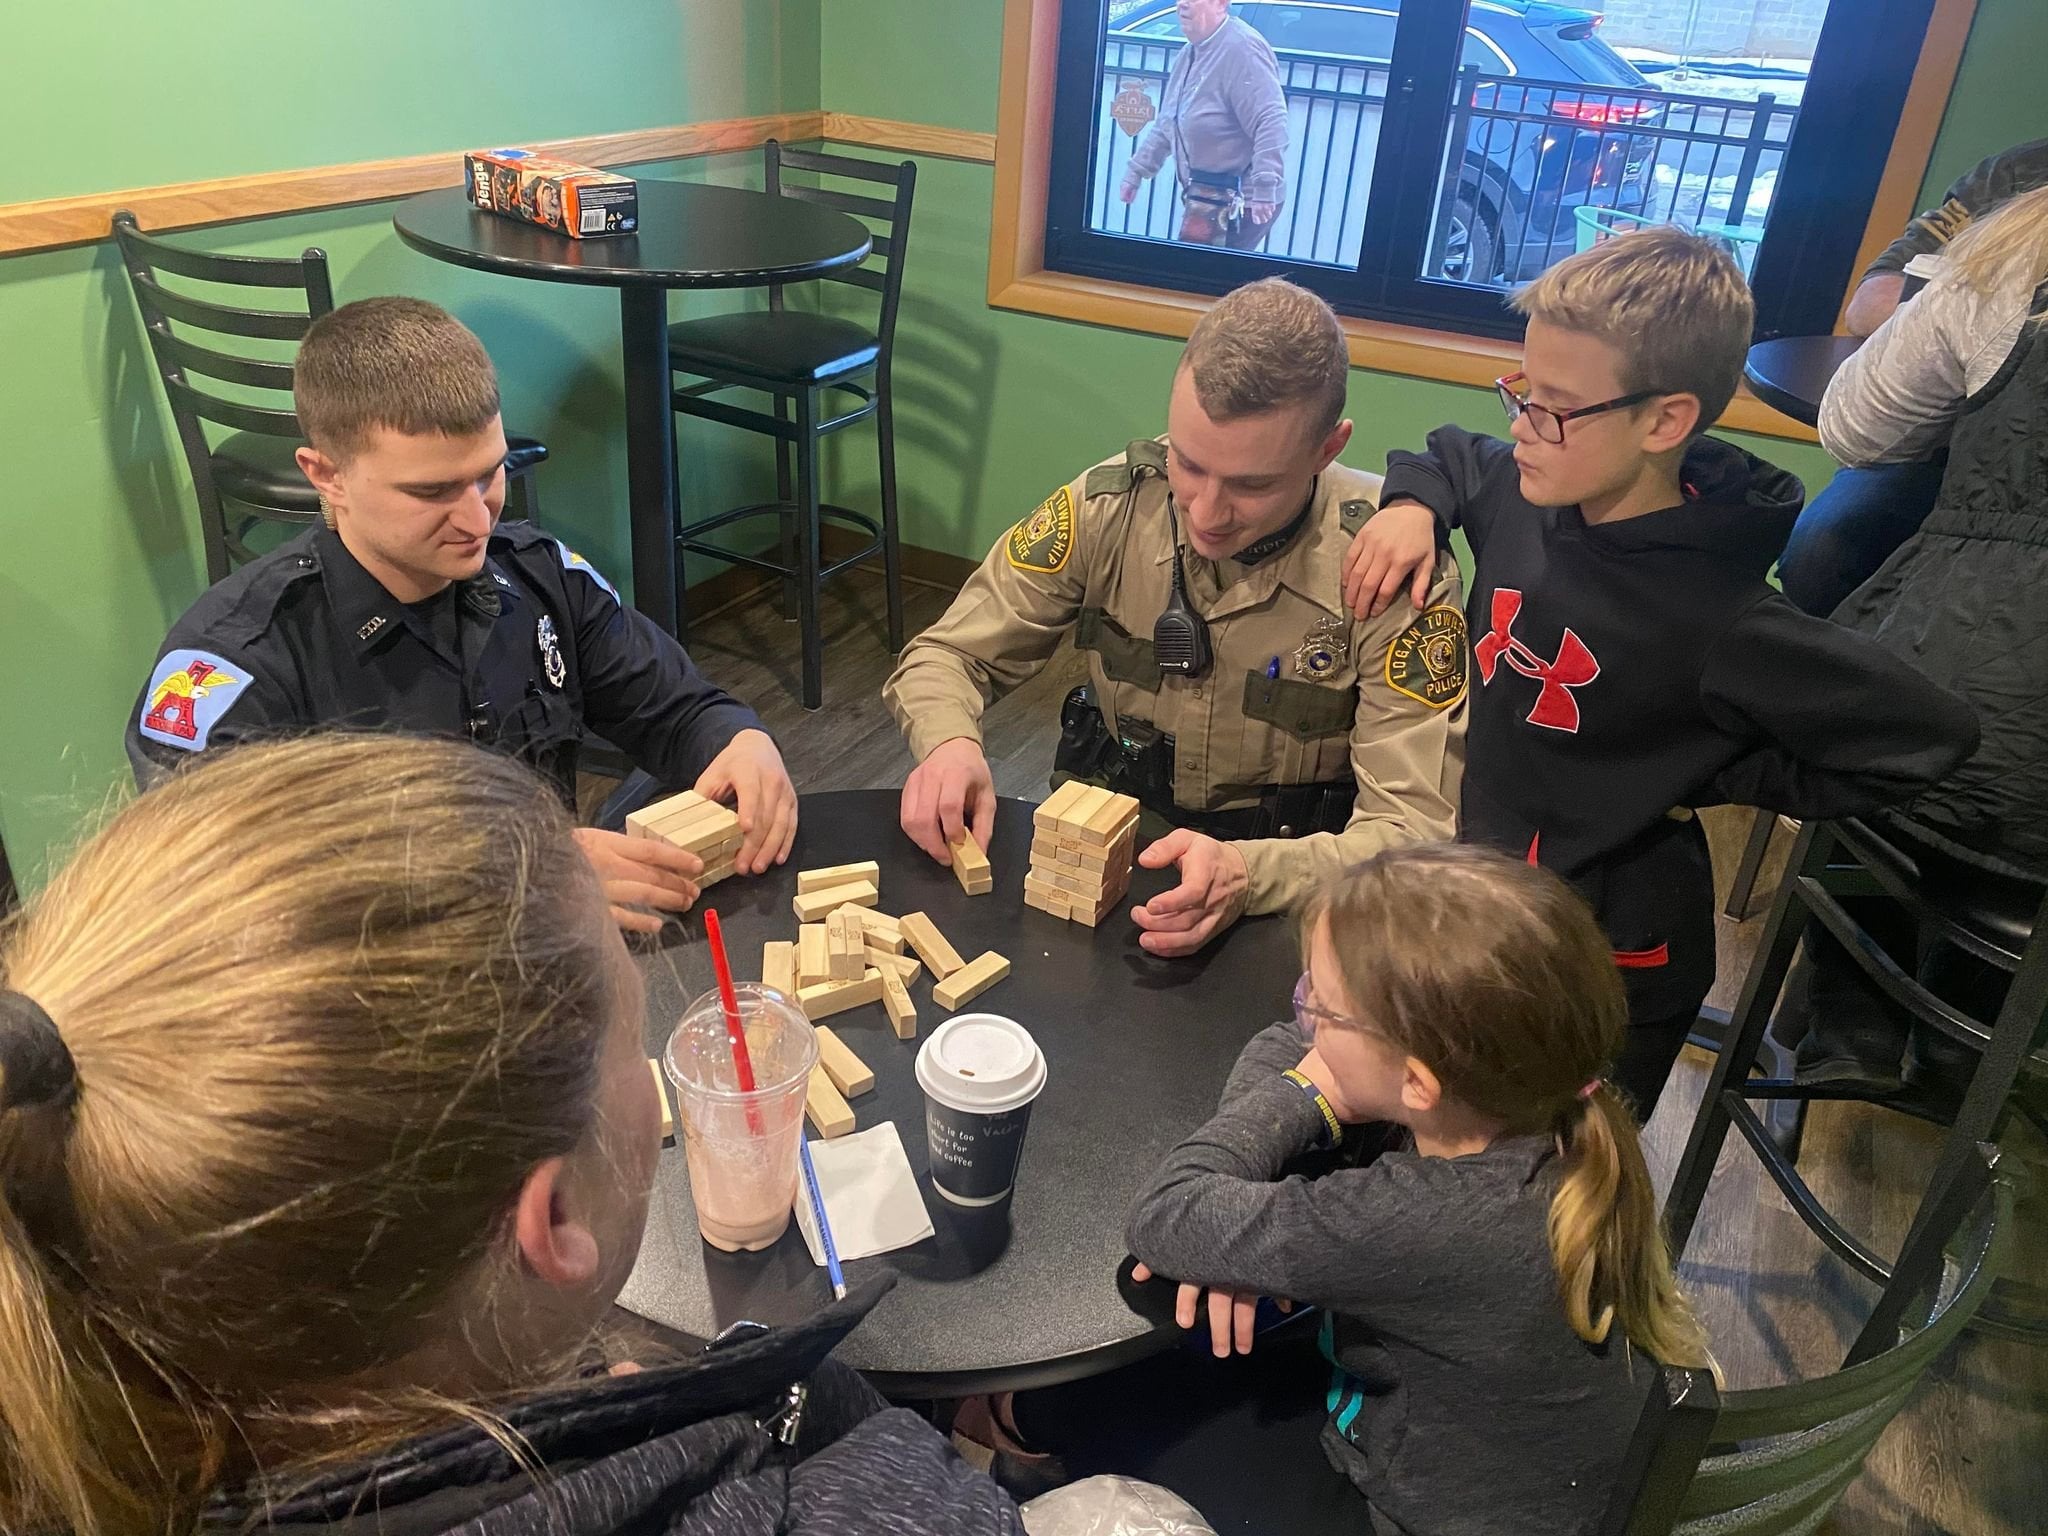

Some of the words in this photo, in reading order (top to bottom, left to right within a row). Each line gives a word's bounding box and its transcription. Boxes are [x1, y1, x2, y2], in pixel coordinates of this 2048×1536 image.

[473, 162, 491, 208] Jenga
[1013, 526, 1031, 561] POLICE
[1048, 493, 1069, 565] TOWNSHIP
[1392, 627, 1422, 680] LOGAN
[1424, 613, 1466, 642] TOWNS
[1426, 673, 1463, 698] POLICE
[929, 1111, 945, 1132] Life
[947, 1126, 955, 1138] is
[959, 1131, 975, 1141] too
[944, 1152, 973, 1168] coffee
[952, 1141, 968, 1153] for
